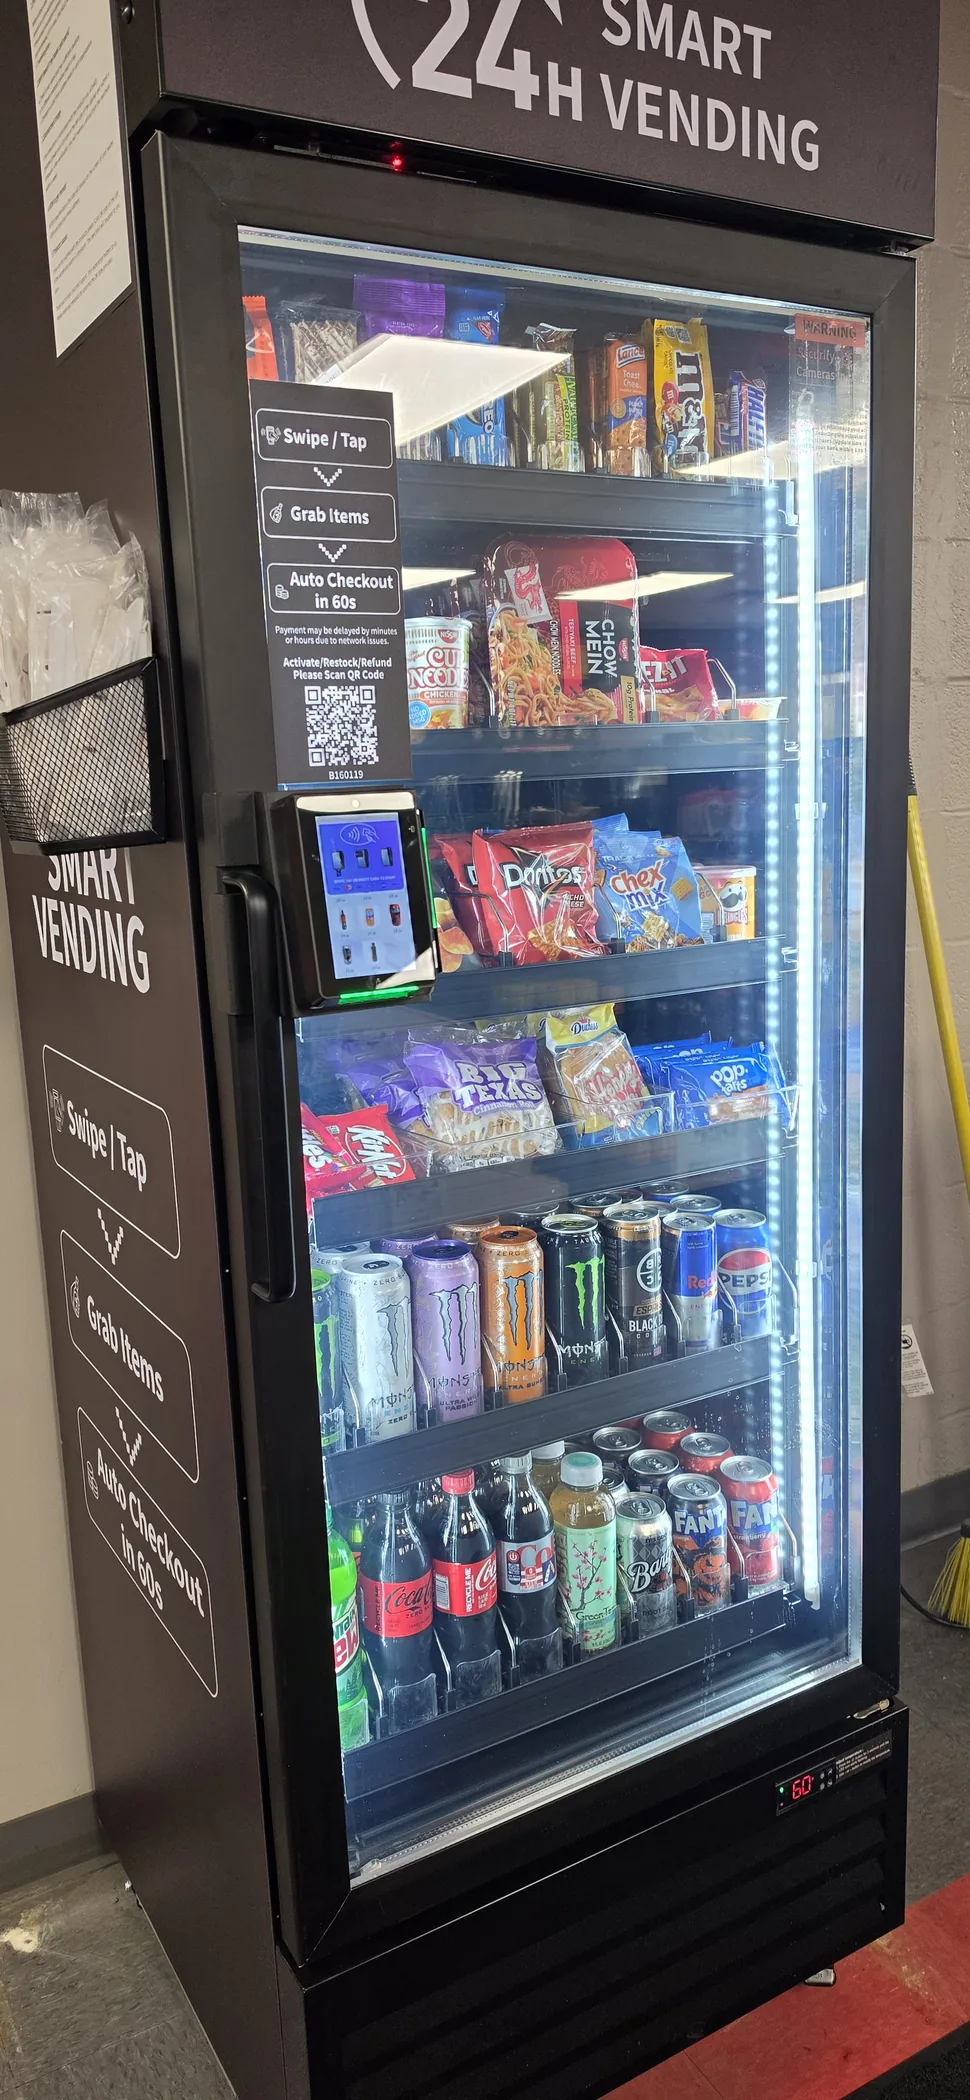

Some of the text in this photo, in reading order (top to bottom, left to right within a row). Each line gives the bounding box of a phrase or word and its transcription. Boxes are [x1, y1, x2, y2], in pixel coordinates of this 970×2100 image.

[602, 0, 772, 79] SMART
[600, 73, 820, 171] VENDING
[802, 319, 857, 339] WARNING
[622, 369, 640, 379] Toast
[796, 365, 835, 381] Cameras
[482, 398, 495, 433] REO
[562, 398, 571, 440] PROTEIN
[283, 427, 367, 452] Swipe / Tap
[290, 506, 370, 525] Grab Items
[289, 571, 394, 590] Auto Checkout
[315, 593, 357, 610] in 60s
[275, 625, 398, 637] Payment may be delayed by minutes
[293, 636, 315, 645] hours
[315, 637, 329, 645] due
[329, 637, 338, 645] to
[338, 637, 366, 645] network
[366, 637, 390, 646] issues.
[549, 620, 561, 676] CHOW MEIN NOODLES
[585, 620, 604, 675] MEIN
[601, 618, 618, 678] CHOW
[621, 638, 629, 661] NISSIN
[283, 657, 392, 668] Activate/Restock/Refund
[293, 669, 385, 681] Please Scan QR Code
[423, 691, 460, 699] CHICKEN
[625, 681, 635, 722] 10g Protein
[328, 770, 364, 781] B160119
[502, 863, 583, 889] Doritos
[715, 905, 749, 927] RINGLES
[31, 894, 151, 994] VENDING
[456, 1062, 527, 1084] BIG
[454, 1081, 543, 1110] TEXAS
[66, 1099, 108, 1159] Swipe
[116, 1130, 148, 1193] Tap
[316, 1257, 338, 1266] ZERO
[373, 1276, 396, 1286] ZERO
[629, 1317, 658, 1332] BLACK
[86, 1295, 165, 1403] Grab Items
[387, 1413, 408, 1425] ZERO
[674, 1504, 727, 1535] FANT
[730, 1492, 779, 1529] FAN
[96, 1448, 206, 1618] Auto Checkout
[120, 1523, 164, 1611] in 60s
[464, 1567, 472, 1579] ME
[405, 1609, 423, 1619] ZERO
[575, 1610, 604, 1621] Green
